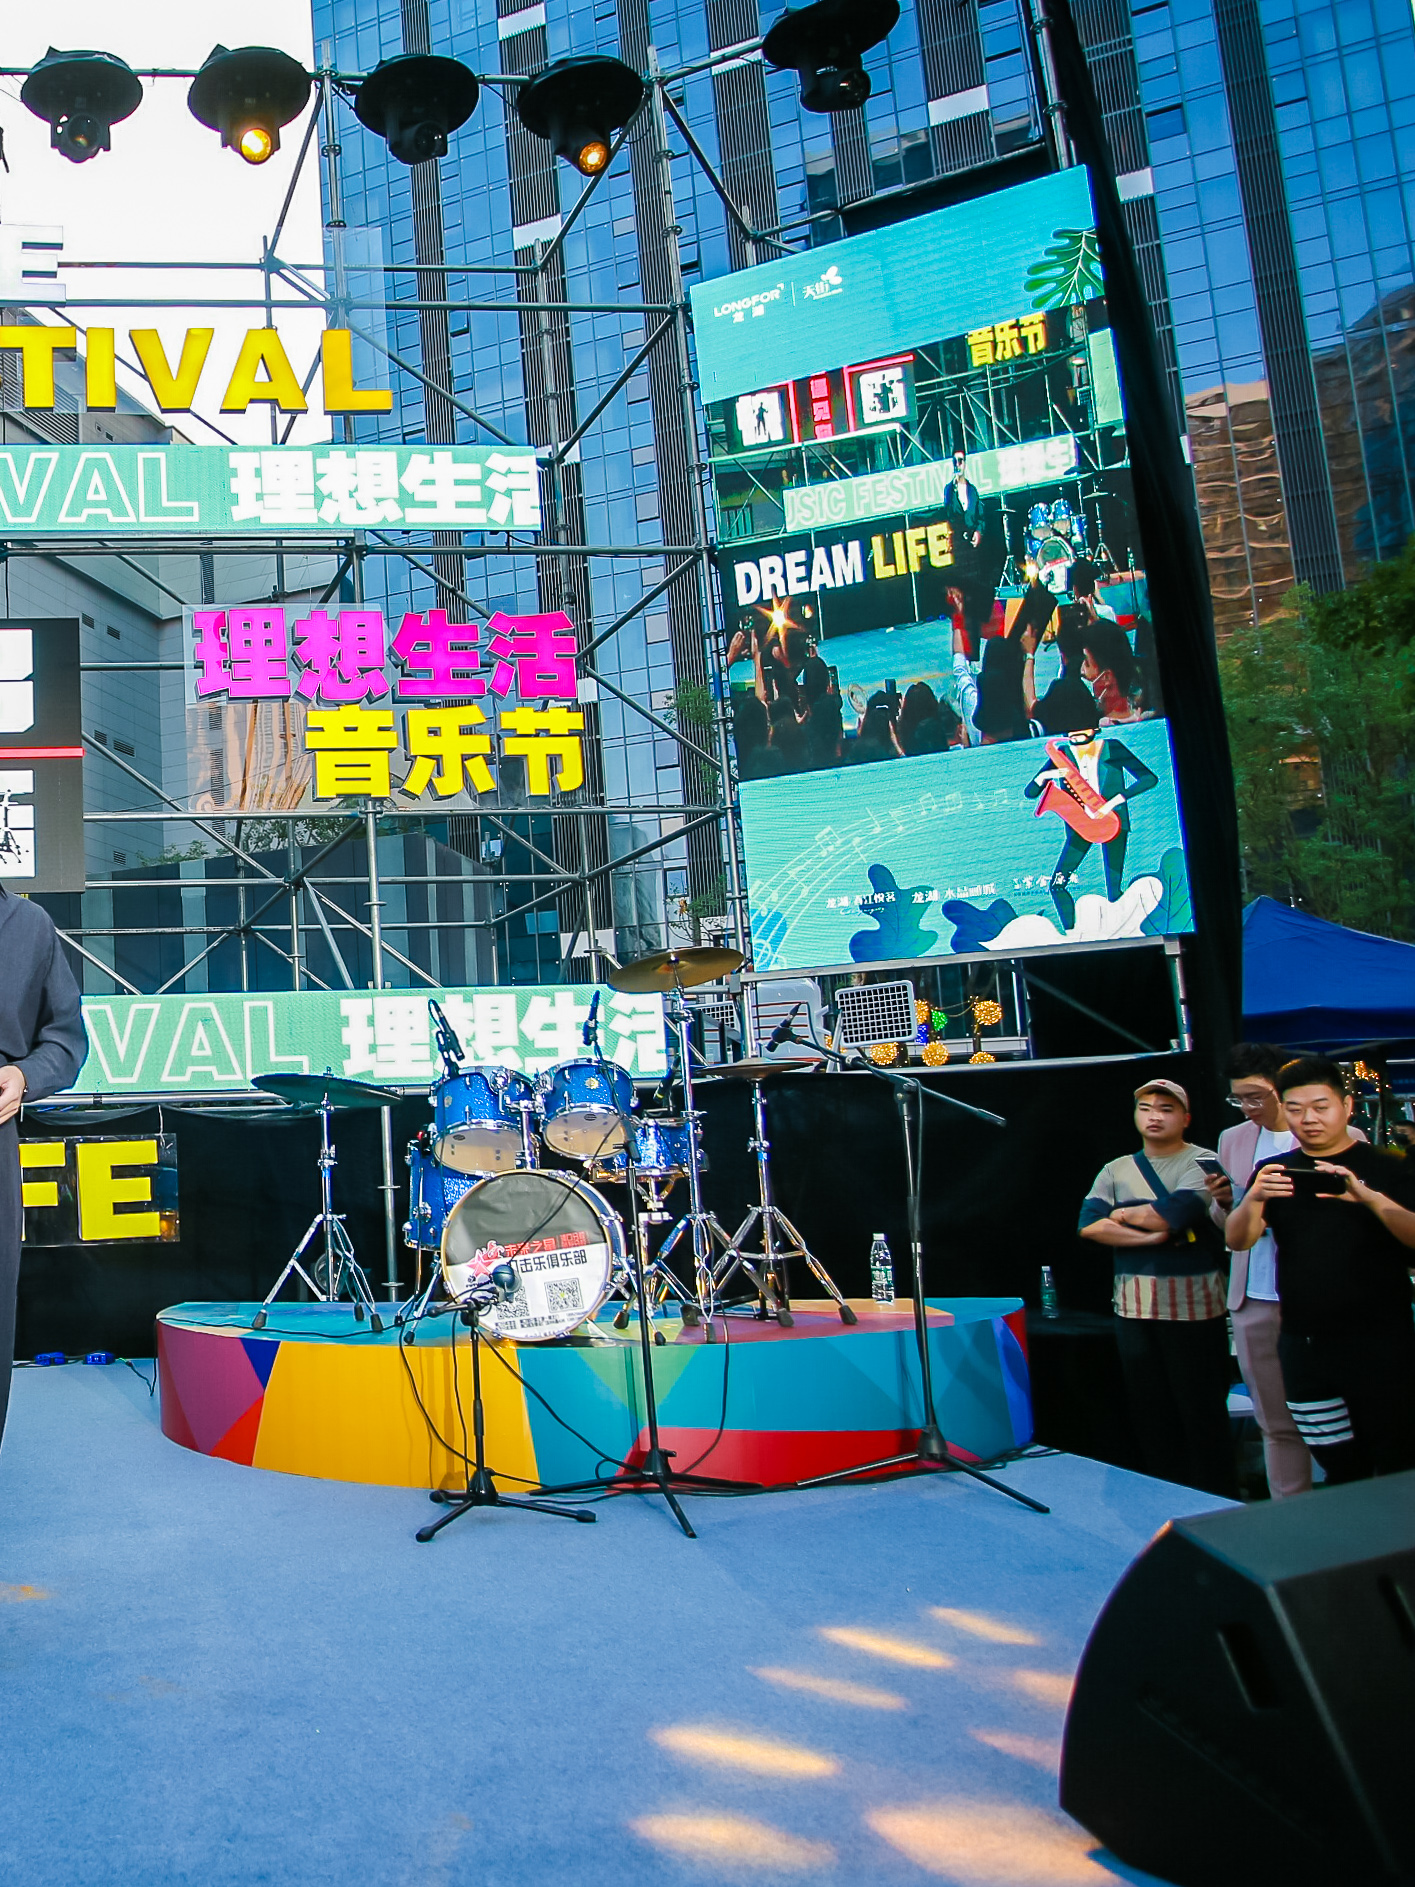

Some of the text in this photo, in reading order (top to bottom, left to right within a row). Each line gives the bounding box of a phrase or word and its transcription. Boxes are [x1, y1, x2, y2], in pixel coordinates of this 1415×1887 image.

[713, 288, 781, 318] LONGFOR
[966, 311, 1048, 368] 音乐节
[733, 521, 956, 608] DREAM LIFE
[192, 606, 579, 702] 理想生活
[304, 703, 585, 802] 音乐节
